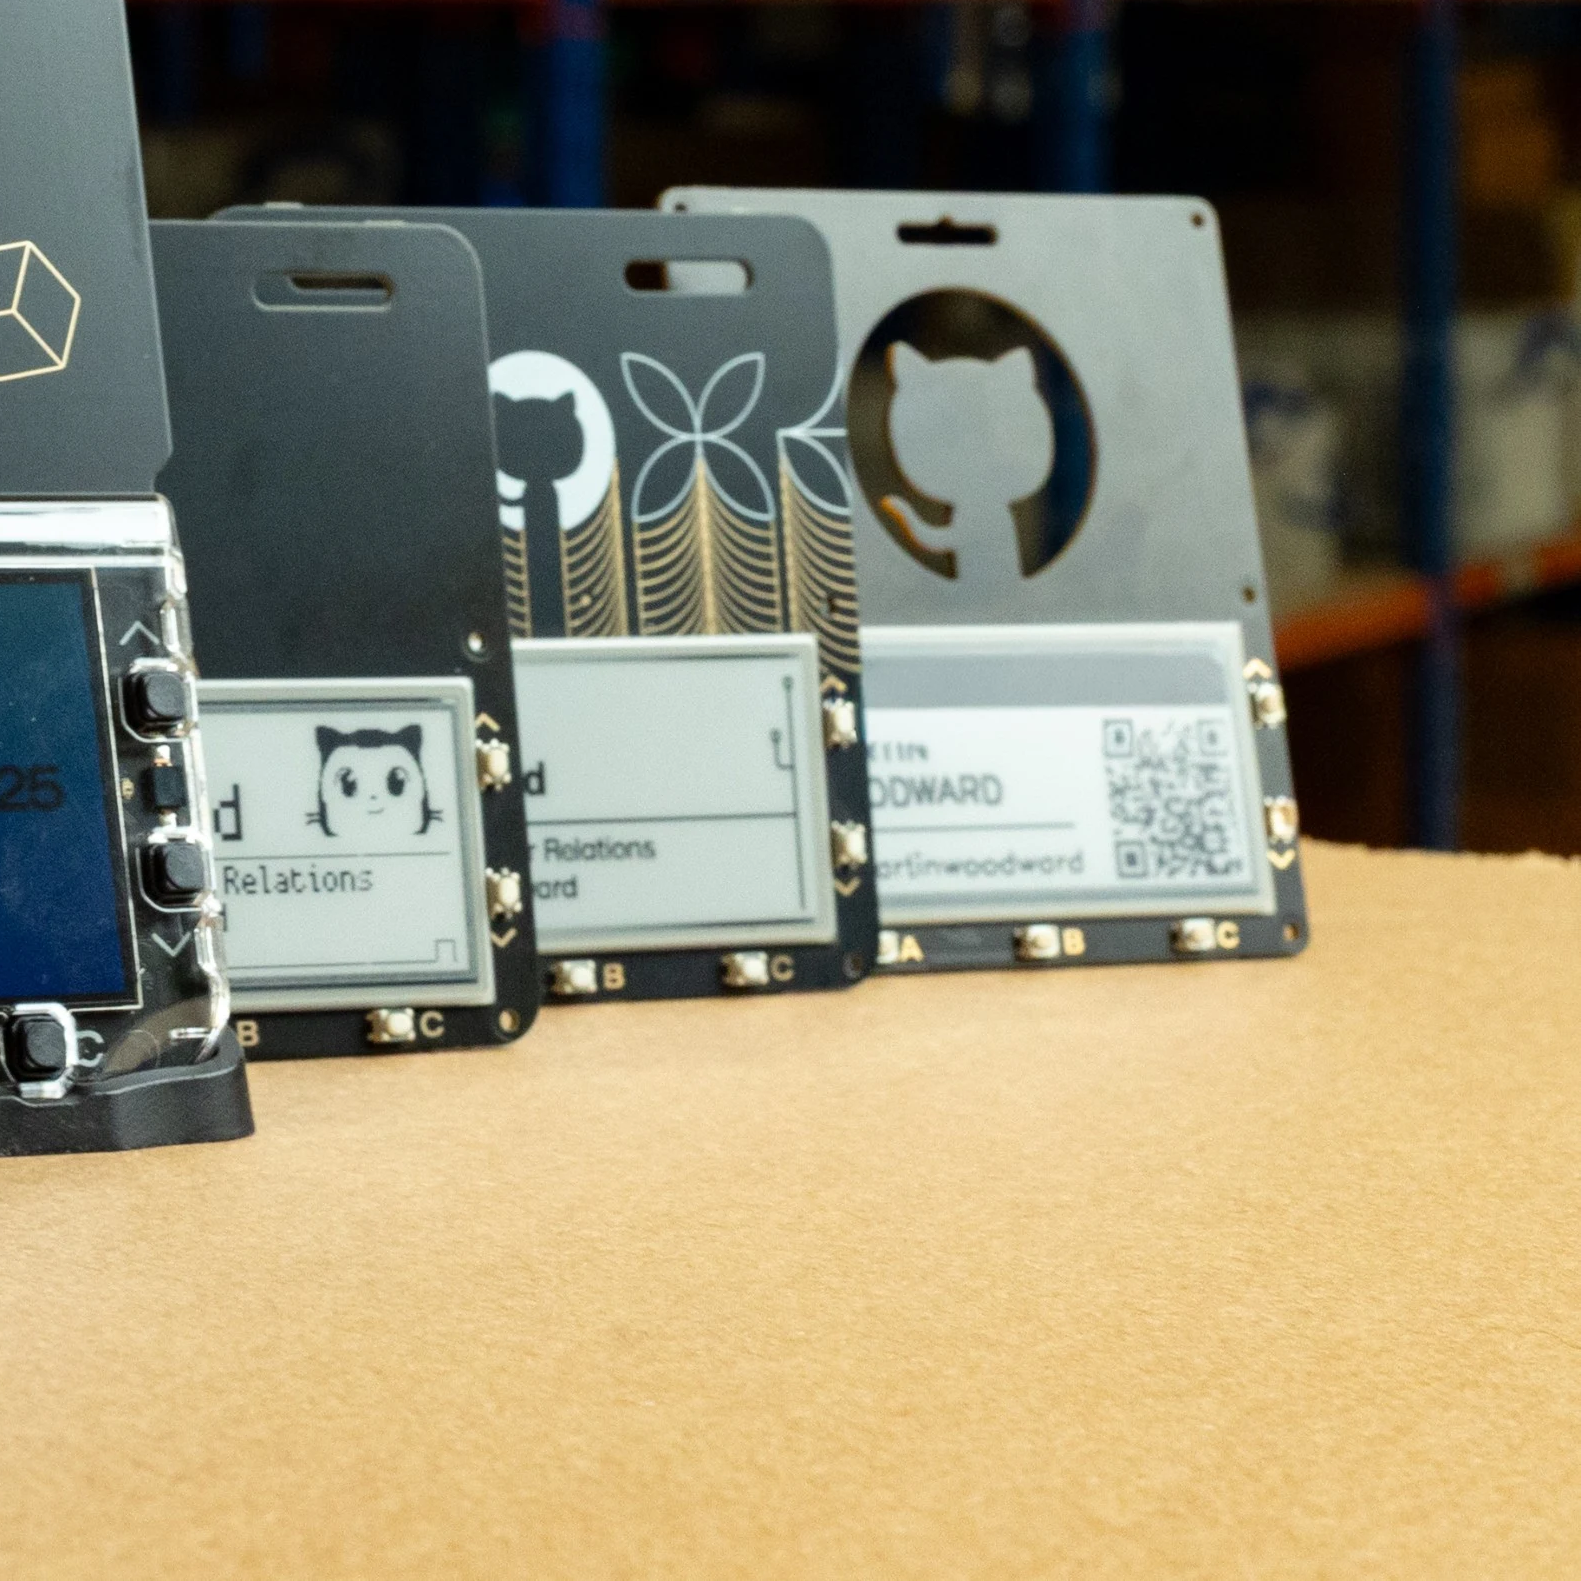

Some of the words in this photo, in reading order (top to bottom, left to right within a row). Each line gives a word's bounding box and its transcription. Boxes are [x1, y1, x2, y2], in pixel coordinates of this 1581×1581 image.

[543, 836, 656, 862] Relations
[222, 864, 373, 895] Relations
[531, 875, 578, 900] ard
[900, 934, 925, 963] A
[1062, 927, 1087, 957] B
[1218, 920, 1241, 950] C
[603, 962, 626, 990] B
[770, 954, 794, 982] C
[236, 1020, 260, 1047] B
[420, 1010, 445, 1038] C
[74, 1030, 105, 1068] C
